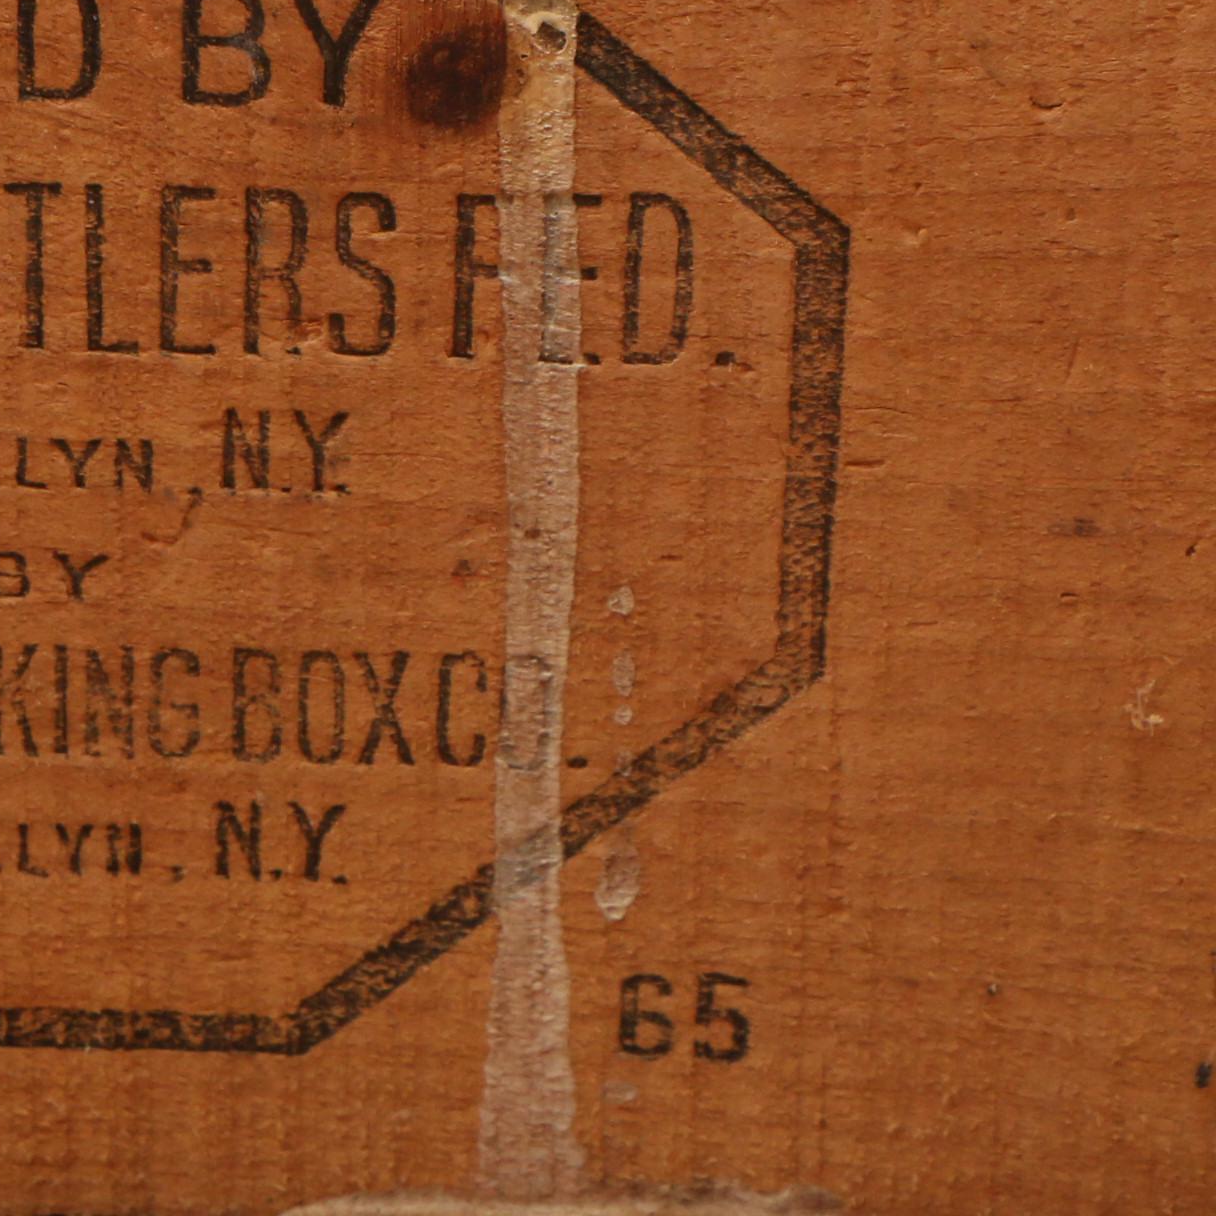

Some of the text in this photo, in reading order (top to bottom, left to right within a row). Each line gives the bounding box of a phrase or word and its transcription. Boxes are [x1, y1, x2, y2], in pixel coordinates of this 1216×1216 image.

[220, 406, 350, 496] N.Y.
[230, 646, 416, 767] BOX
[214, 798, 348, 885] N.Y.
[617, 972, 750, 1063] 65
